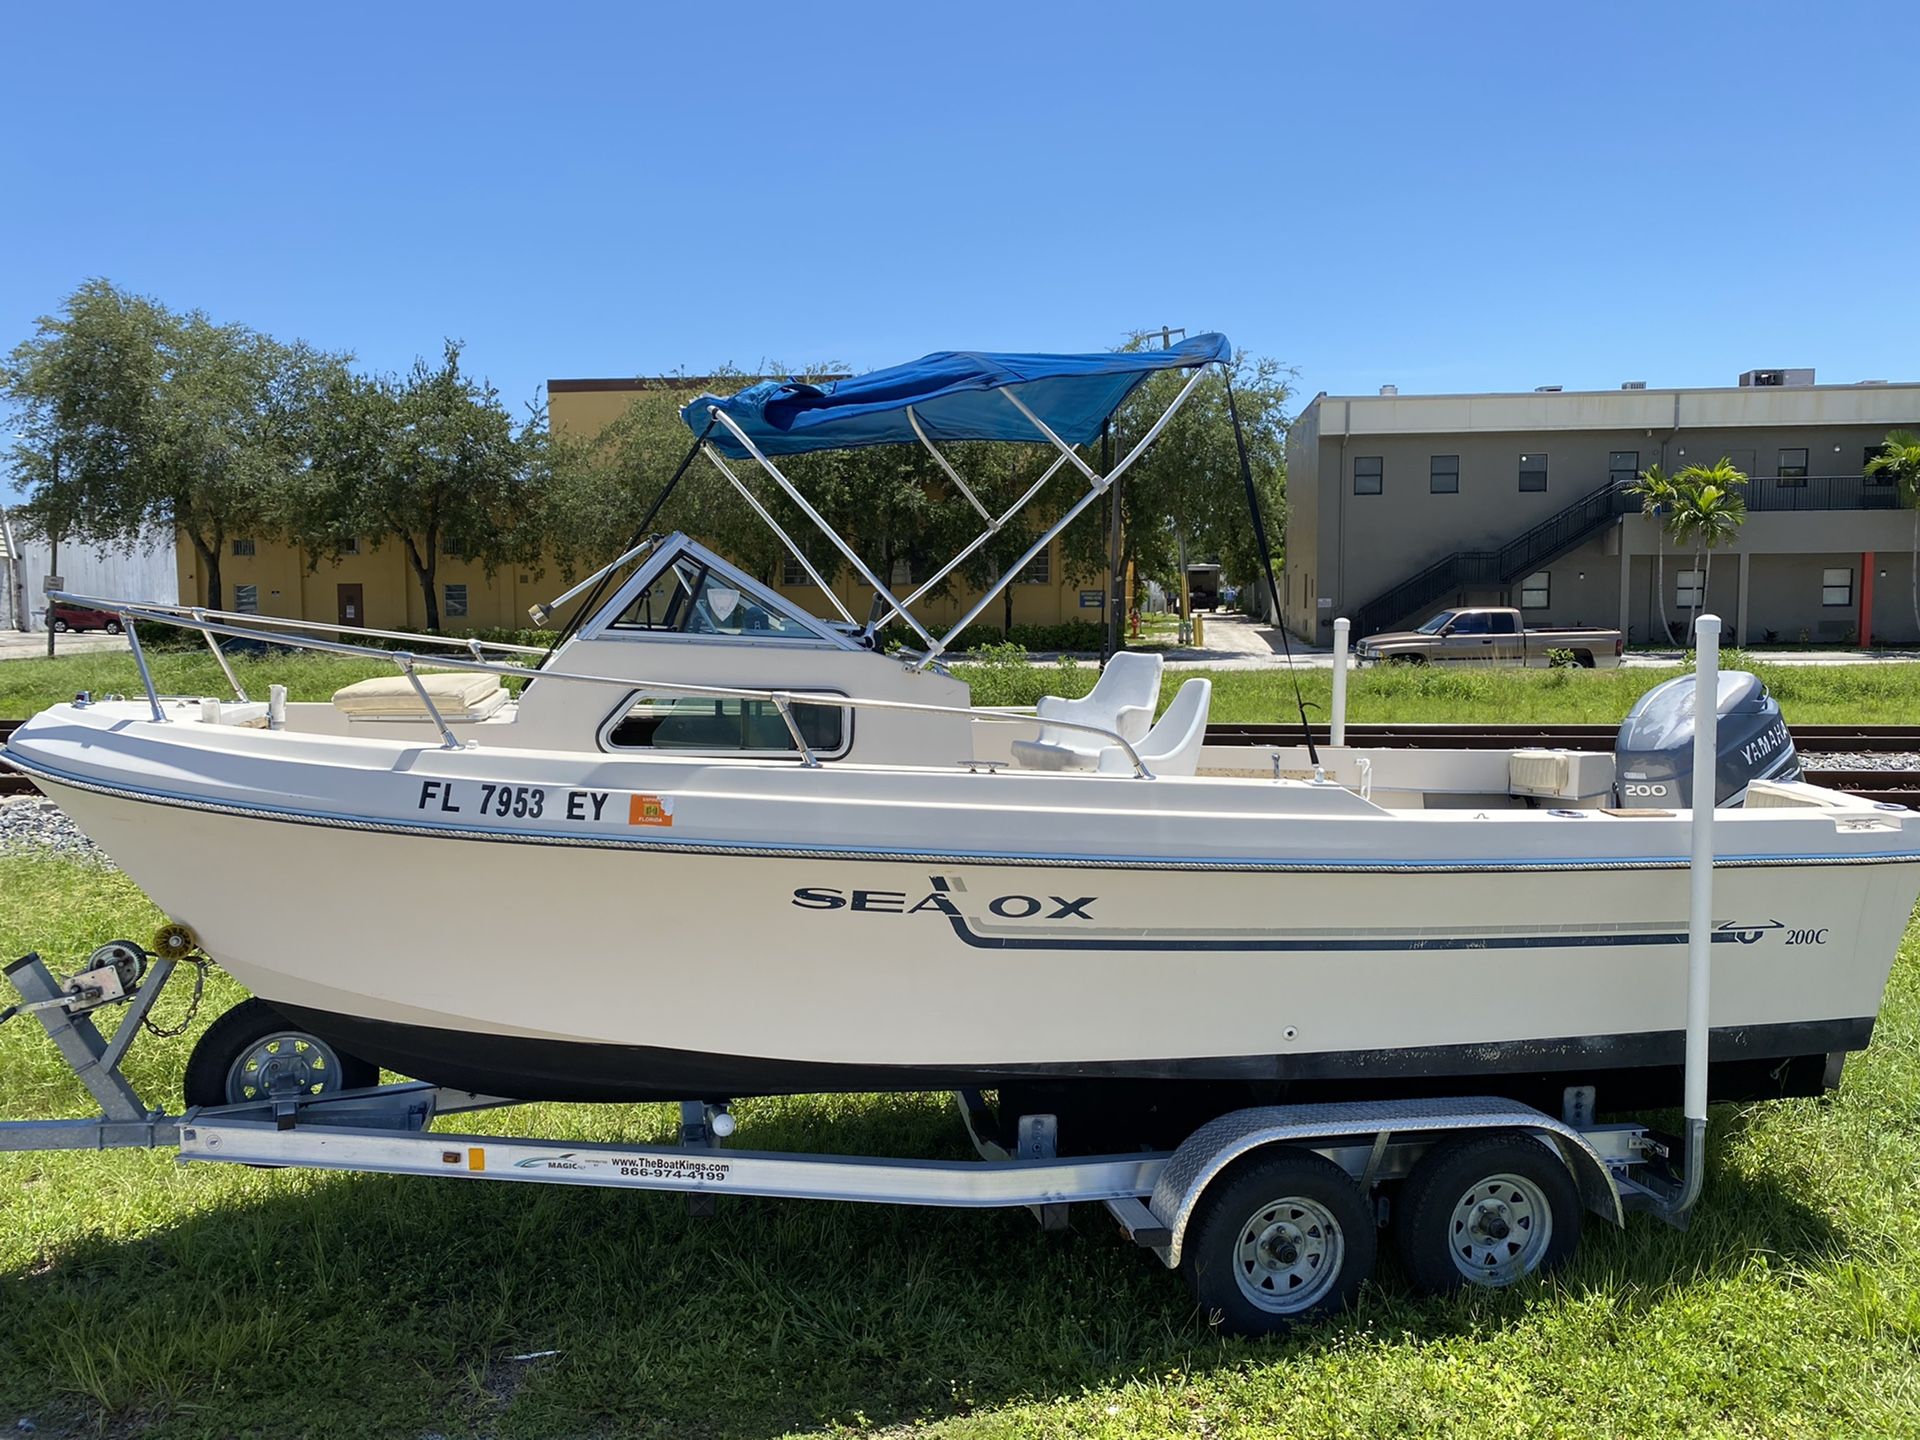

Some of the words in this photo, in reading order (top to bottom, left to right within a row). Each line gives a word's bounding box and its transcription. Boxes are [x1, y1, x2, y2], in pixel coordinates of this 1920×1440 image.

[1739, 719, 1788, 765] YAMAHA
[1624, 784, 1667, 796] 200
[418, 781, 460, 812] FL
[479, 784, 545, 818] 7953
[566, 791, 609, 821] EY
[791, 885, 961, 916] SEA
[988, 894, 1098, 919] OX
[1785, 928, 1829, 945] 200C
[547, 1161, 577, 1170] MAGIC
[611, 1157, 730, 1173] www.TheBoatKings.com
[620, 1167, 725, 1181] 866-974-4199
